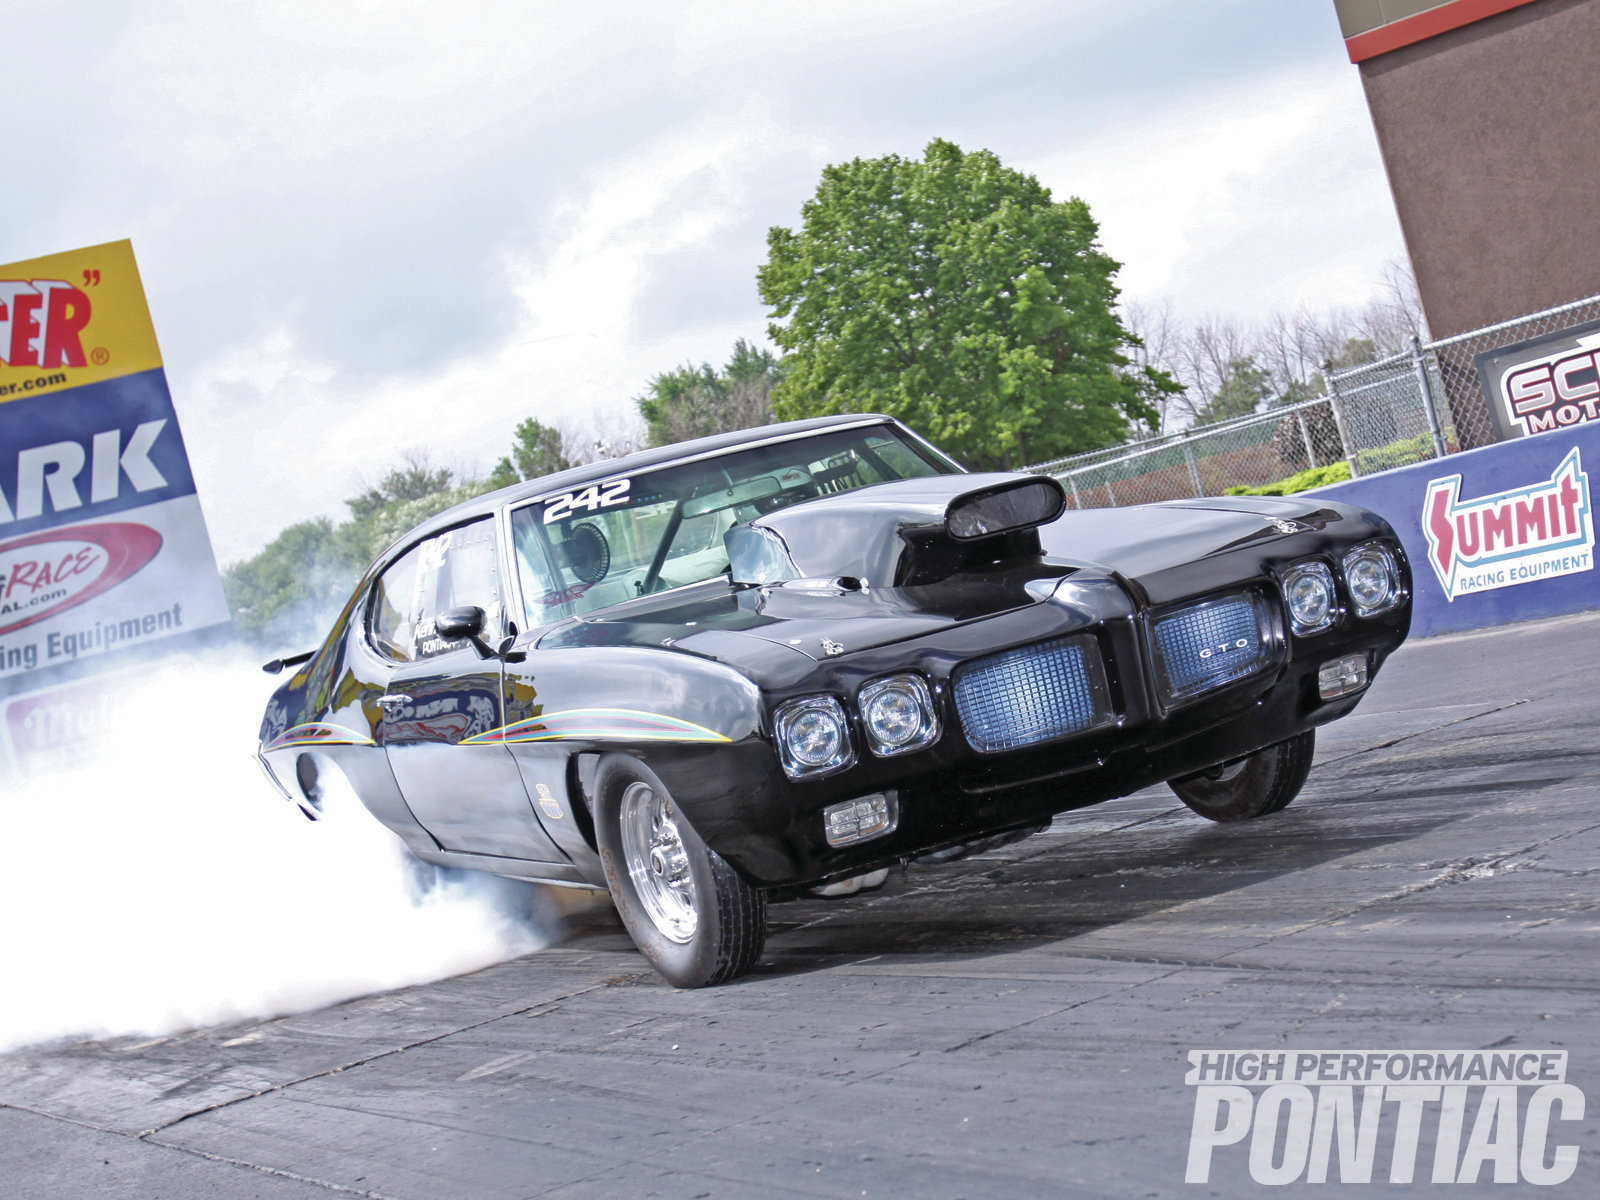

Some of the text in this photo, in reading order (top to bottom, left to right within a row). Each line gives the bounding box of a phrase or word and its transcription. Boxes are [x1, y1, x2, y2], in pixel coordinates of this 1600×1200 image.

[1509, 350, 1600, 415] SC
[543, 478, 631, 525] 242
[5, 546, 100, 598] RACE
[1460, 553, 1589, 591] RACING EQUIPMENT
[47, 603, 183, 658] Equipment
[1199, 638, 1249, 659] GTO
